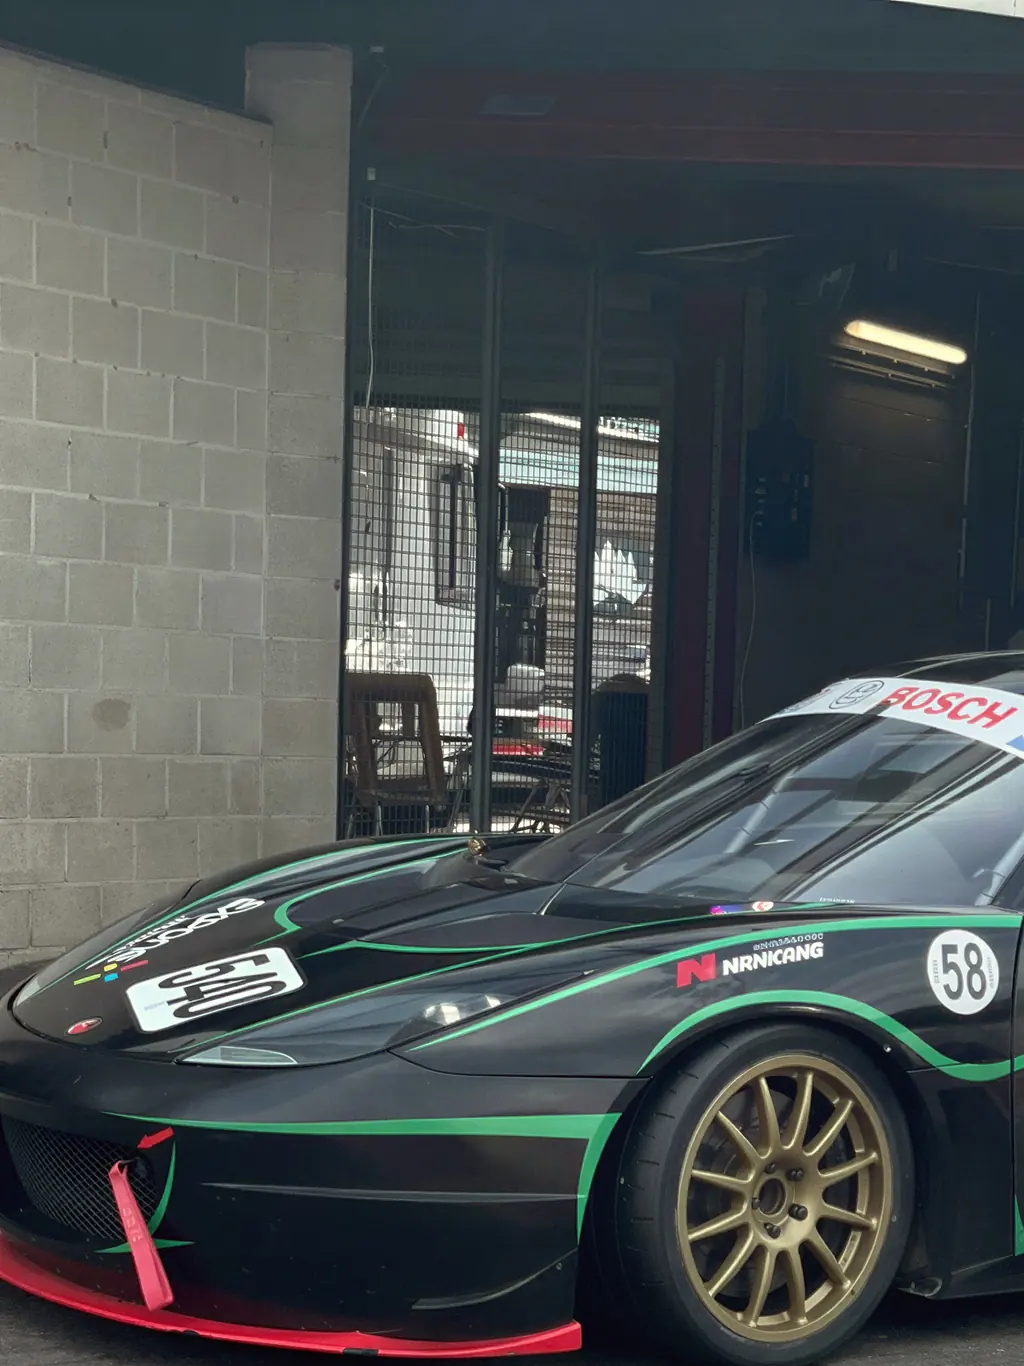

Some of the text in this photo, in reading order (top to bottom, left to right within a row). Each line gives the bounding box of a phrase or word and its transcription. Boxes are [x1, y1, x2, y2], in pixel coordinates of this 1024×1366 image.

[879, 686, 1018, 729] BOSCH
[157, 953, 288, 1018] 540
[941, 942, 987, 1001] 58
